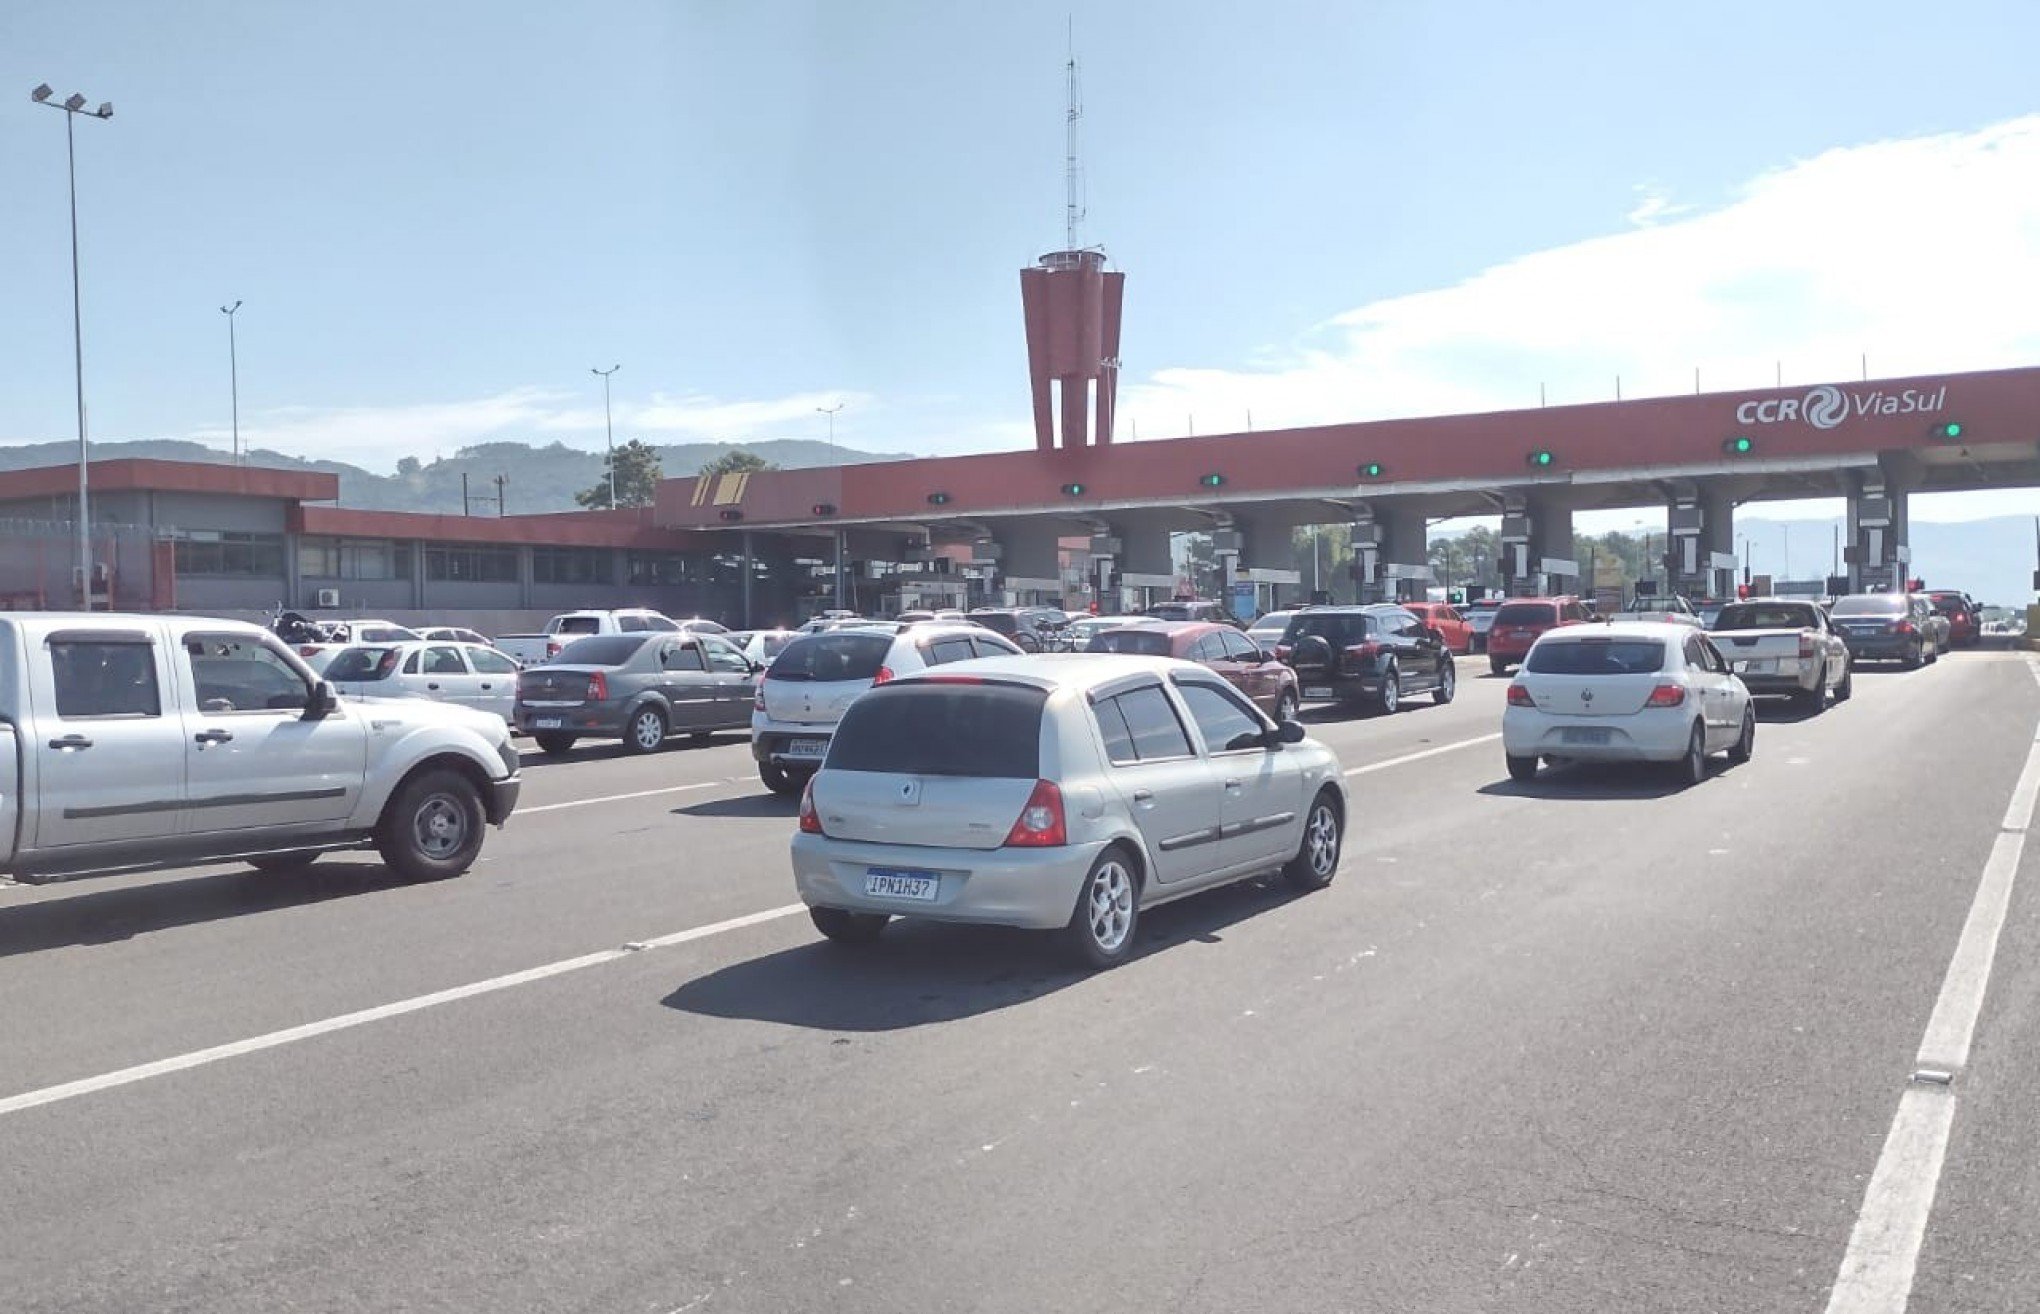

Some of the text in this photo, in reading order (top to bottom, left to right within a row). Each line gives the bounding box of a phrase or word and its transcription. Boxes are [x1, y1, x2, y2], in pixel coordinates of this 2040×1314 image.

[1736, 386, 1947, 424] CCR ViaSul
[870, 877, 930, 896] IPN1H37
